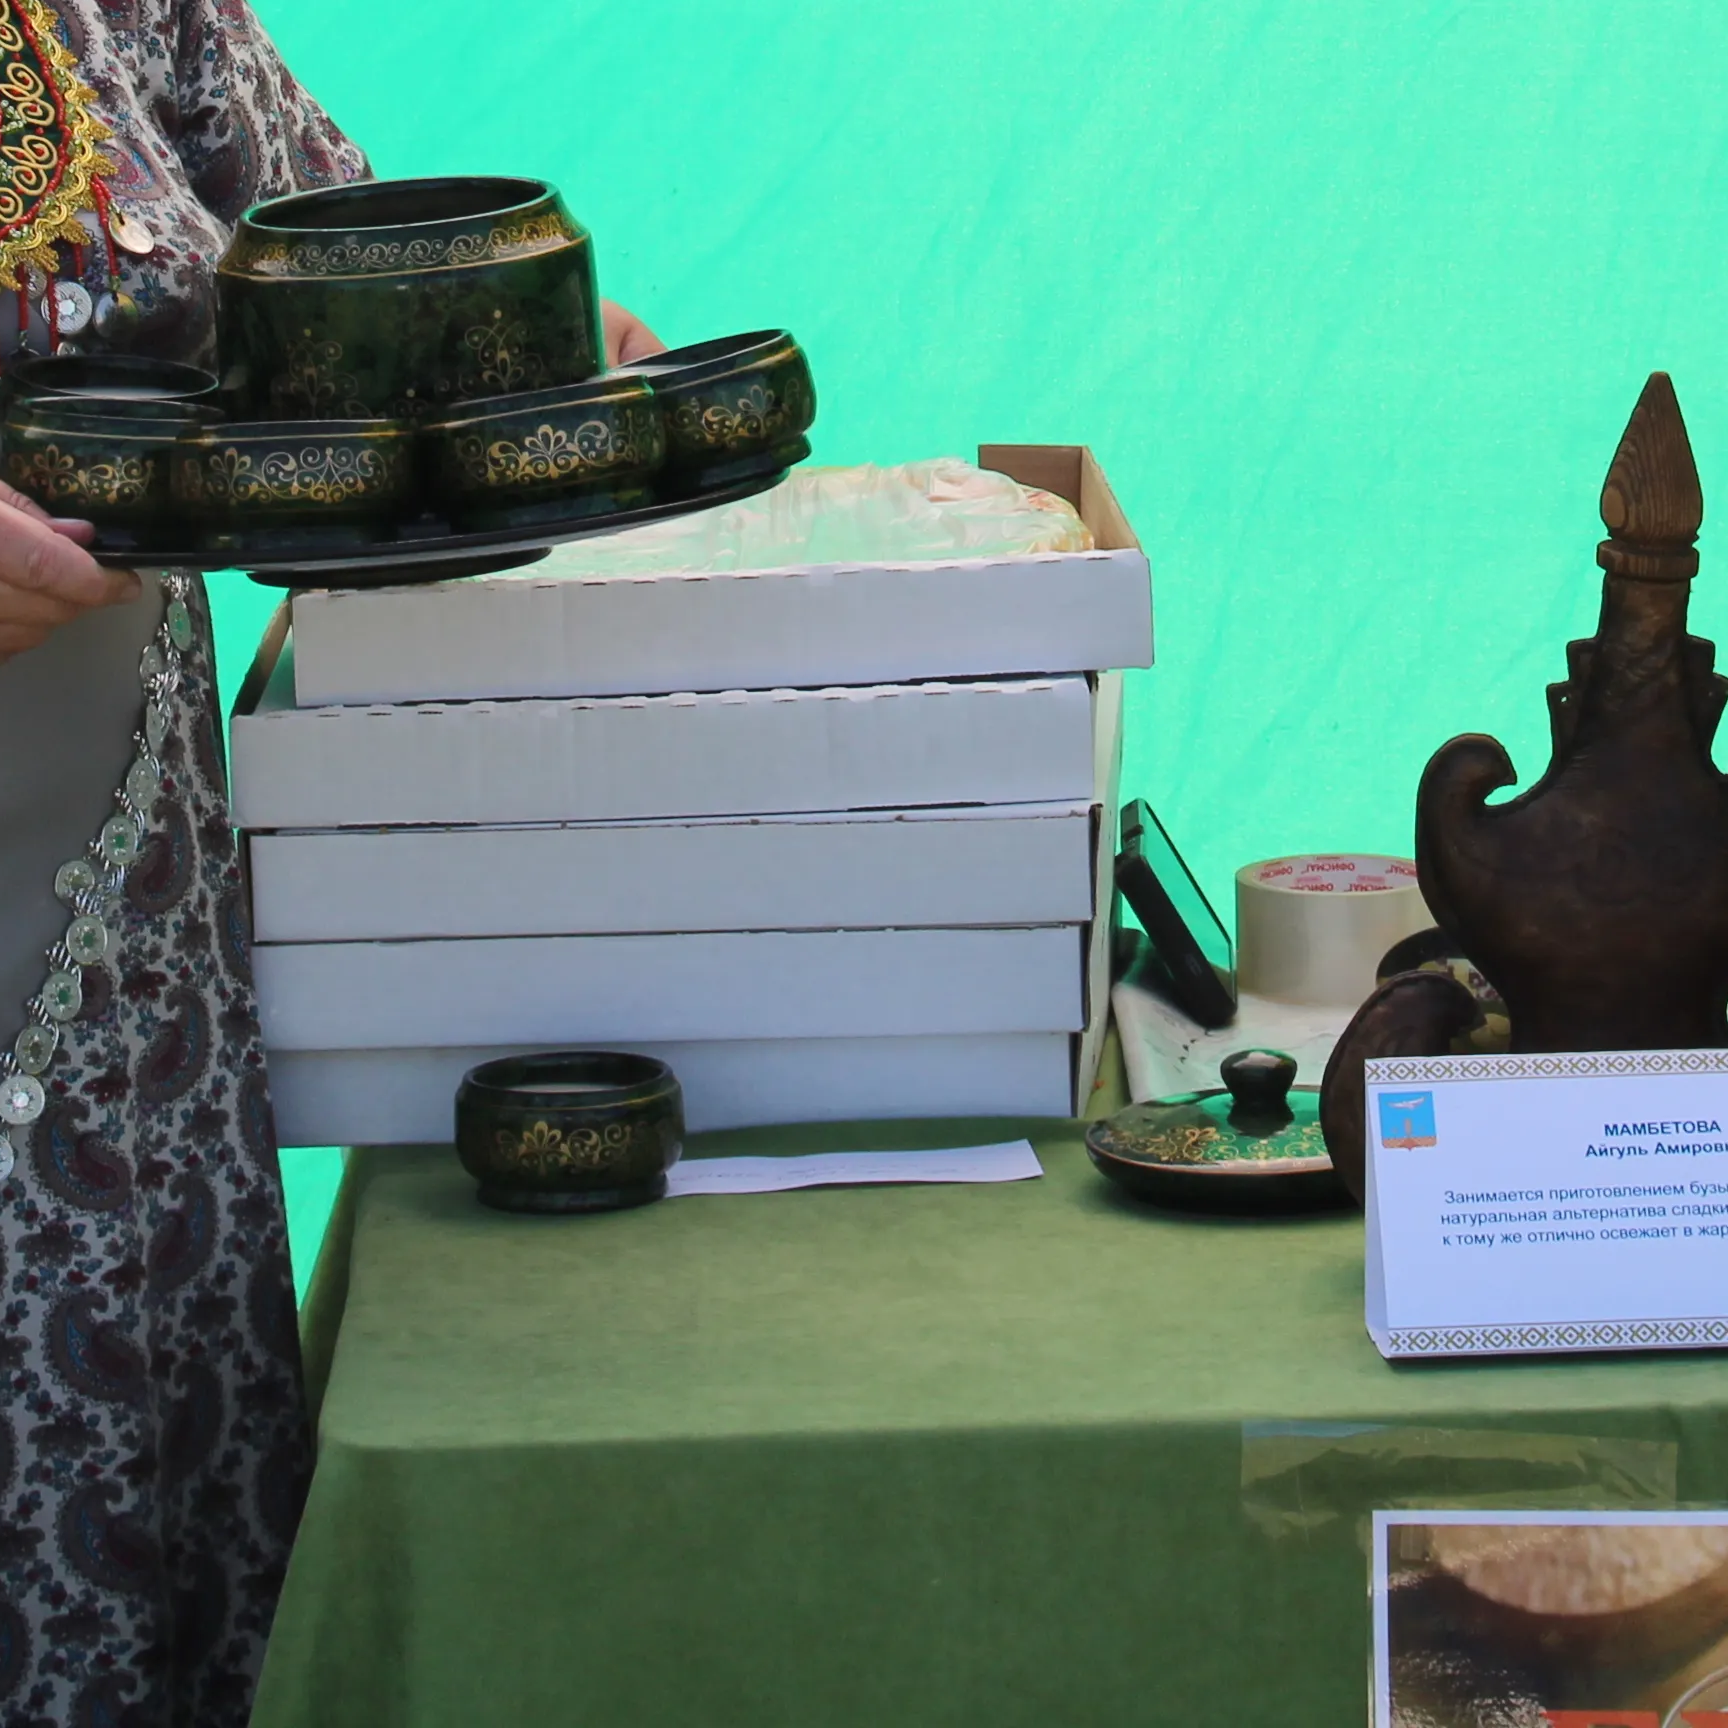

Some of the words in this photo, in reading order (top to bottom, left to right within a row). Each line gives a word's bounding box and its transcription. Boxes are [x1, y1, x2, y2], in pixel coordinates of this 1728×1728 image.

[1604, 1120, 1722, 1138] МАМБЕТОВА
[1585, 1143, 1648, 1160] Айгуль
[1444, 1189, 1544, 1205] Занимается
[1549, 1184, 1686, 1203] приготовлением
[1440, 1210, 1548, 1227] натуральная
[1552, 1205, 1667, 1223] альтернатива
[1442, 1235, 1452, 1247] к
[1456, 1233, 1495, 1249] тому
[1501, 1232, 1523, 1244] же
[1528, 1229, 1596, 1244] отлично
[1600, 1226, 1678, 1240] освежает
[1684, 1226, 1694, 1238] в
